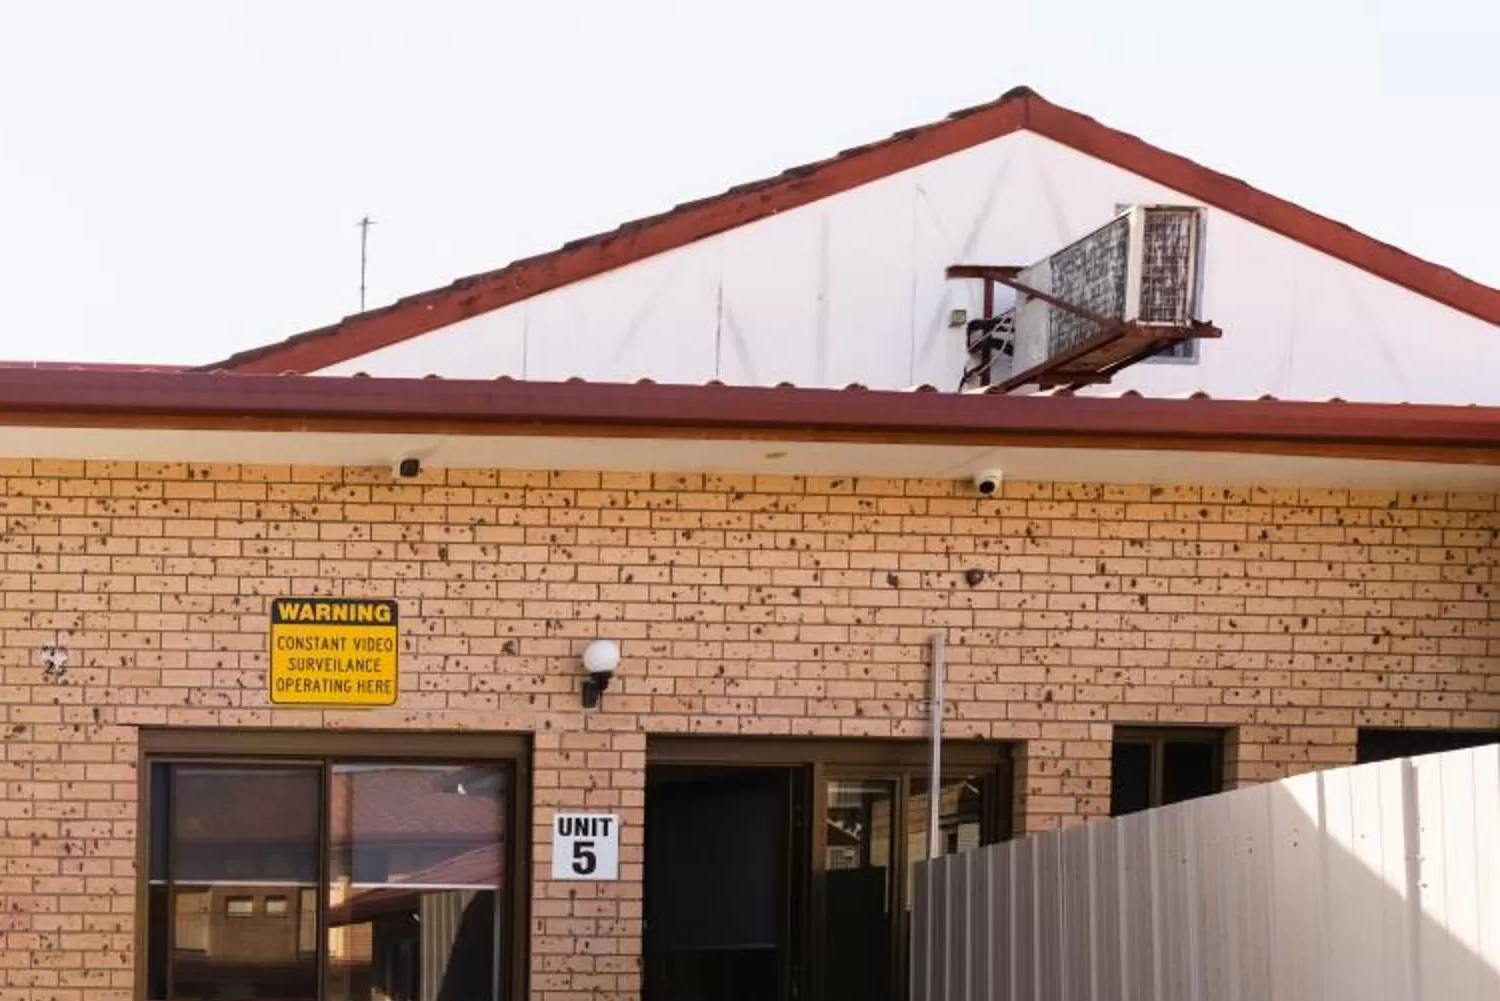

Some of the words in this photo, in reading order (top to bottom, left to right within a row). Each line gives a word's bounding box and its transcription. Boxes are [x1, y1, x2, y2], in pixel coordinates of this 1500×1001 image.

[278, 603, 391, 622] WARNING
[277, 636, 347, 651] CONSTANT
[354, 637, 393, 652] VIDEO
[287, 657, 381, 673] SURVEILANCE
[276, 678, 351, 693] OPERATING
[357, 679, 392, 694] HERE
[558, 817, 613, 837] UNIT
[572, 841, 597, 875] 5
